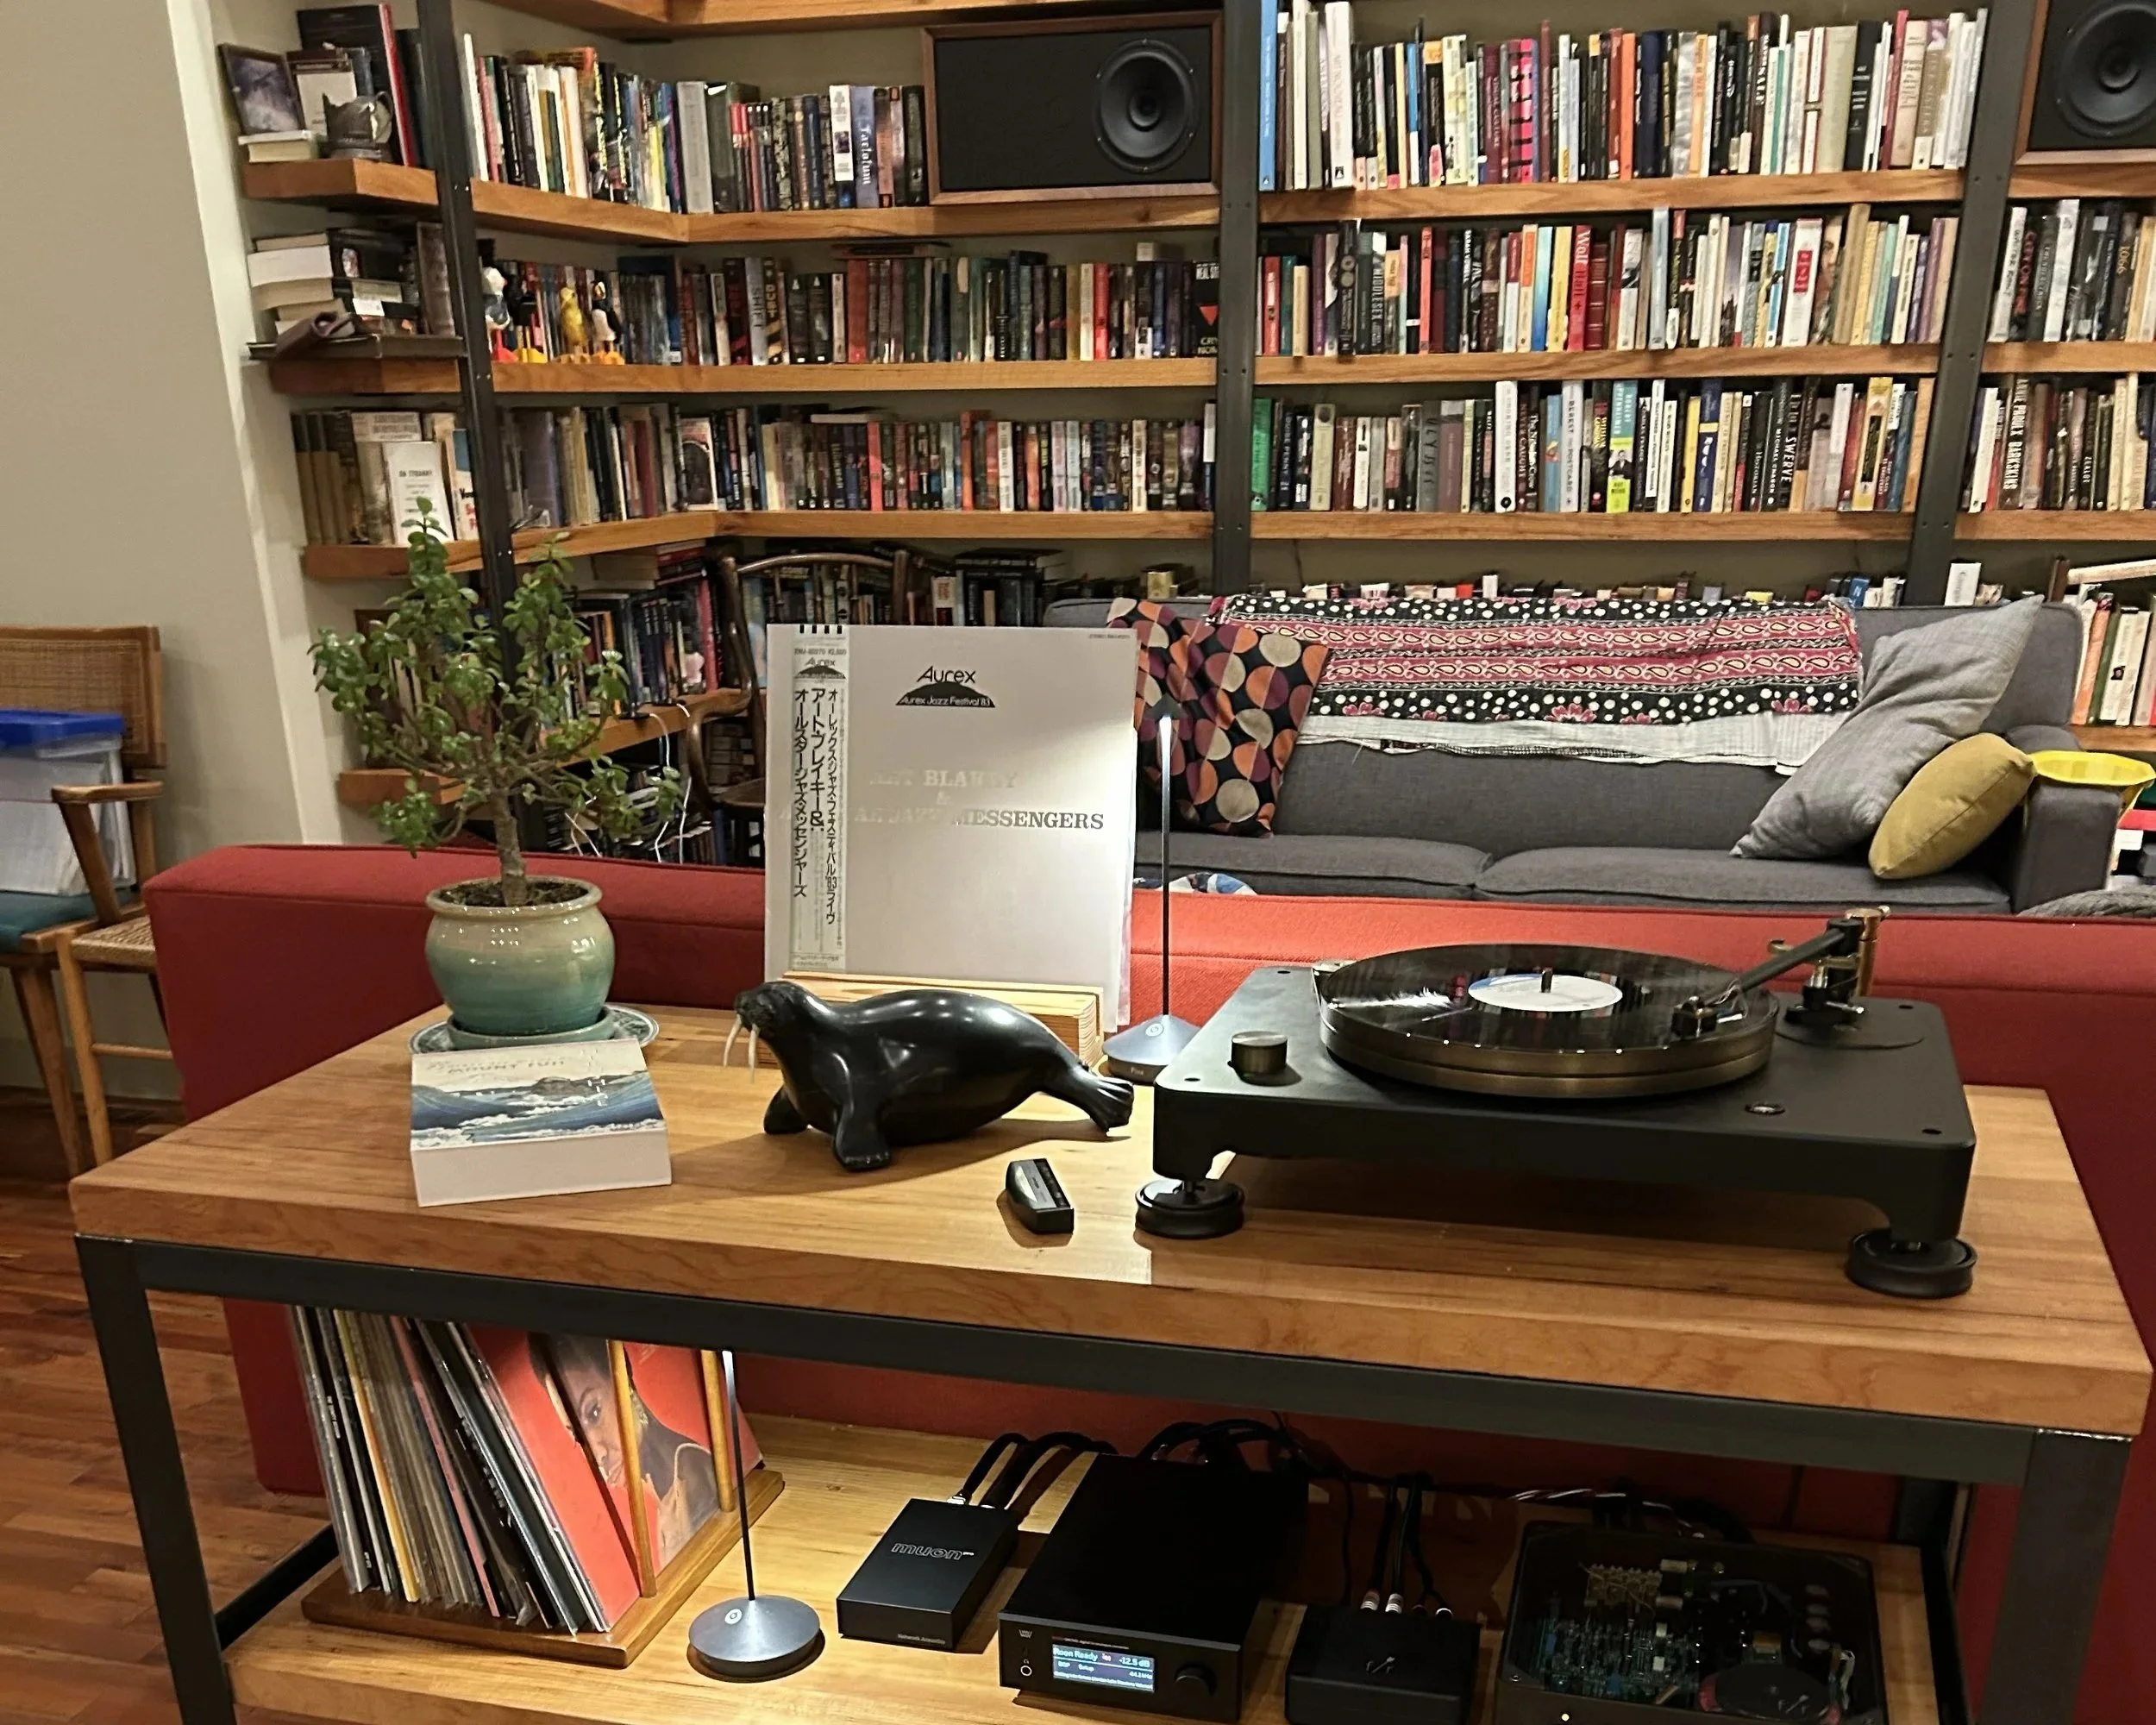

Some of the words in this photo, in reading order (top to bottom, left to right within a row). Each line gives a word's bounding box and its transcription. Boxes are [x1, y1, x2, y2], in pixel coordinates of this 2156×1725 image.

[1574, 229, 1590, 264] Wolf
[764, 283, 777, 319] DUST
[1371, 268, 1386, 320] MIDDLESEX
[1573, 270, 1589, 302] Hall
[751, 287, 764, 329] SHIFT
[1568, 400, 1576, 434] BEREST
[2009, 405, 2027, 436] PROULX
[1282, 445, 1292, 475] PENNY
[1518, 436, 1528, 479] CAUGHT
[1772, 428, 1782, 462] MICHAEL
[1781, 436, 1798, 484] SWERVE
[1565, 448, 1576, 493] POSTCARD
[1752, 451, 1764, 494] HISTORIAN
[2002, 442, 2023, 490] BARKSKINS
[917, 665, 976, 683] Aurex
[899, 696, 925, 705] Aurex
[927, 695, 949, 706] Jazz
[950, 695, 980, 706] Festival
[950, 808, 1105, 829] MESSENGERS
[891, 1542, 963, 1560] muon
[1053, 1647, 1074, 1658] Roon
[1074, 1650, 1099, 1662] Ready
